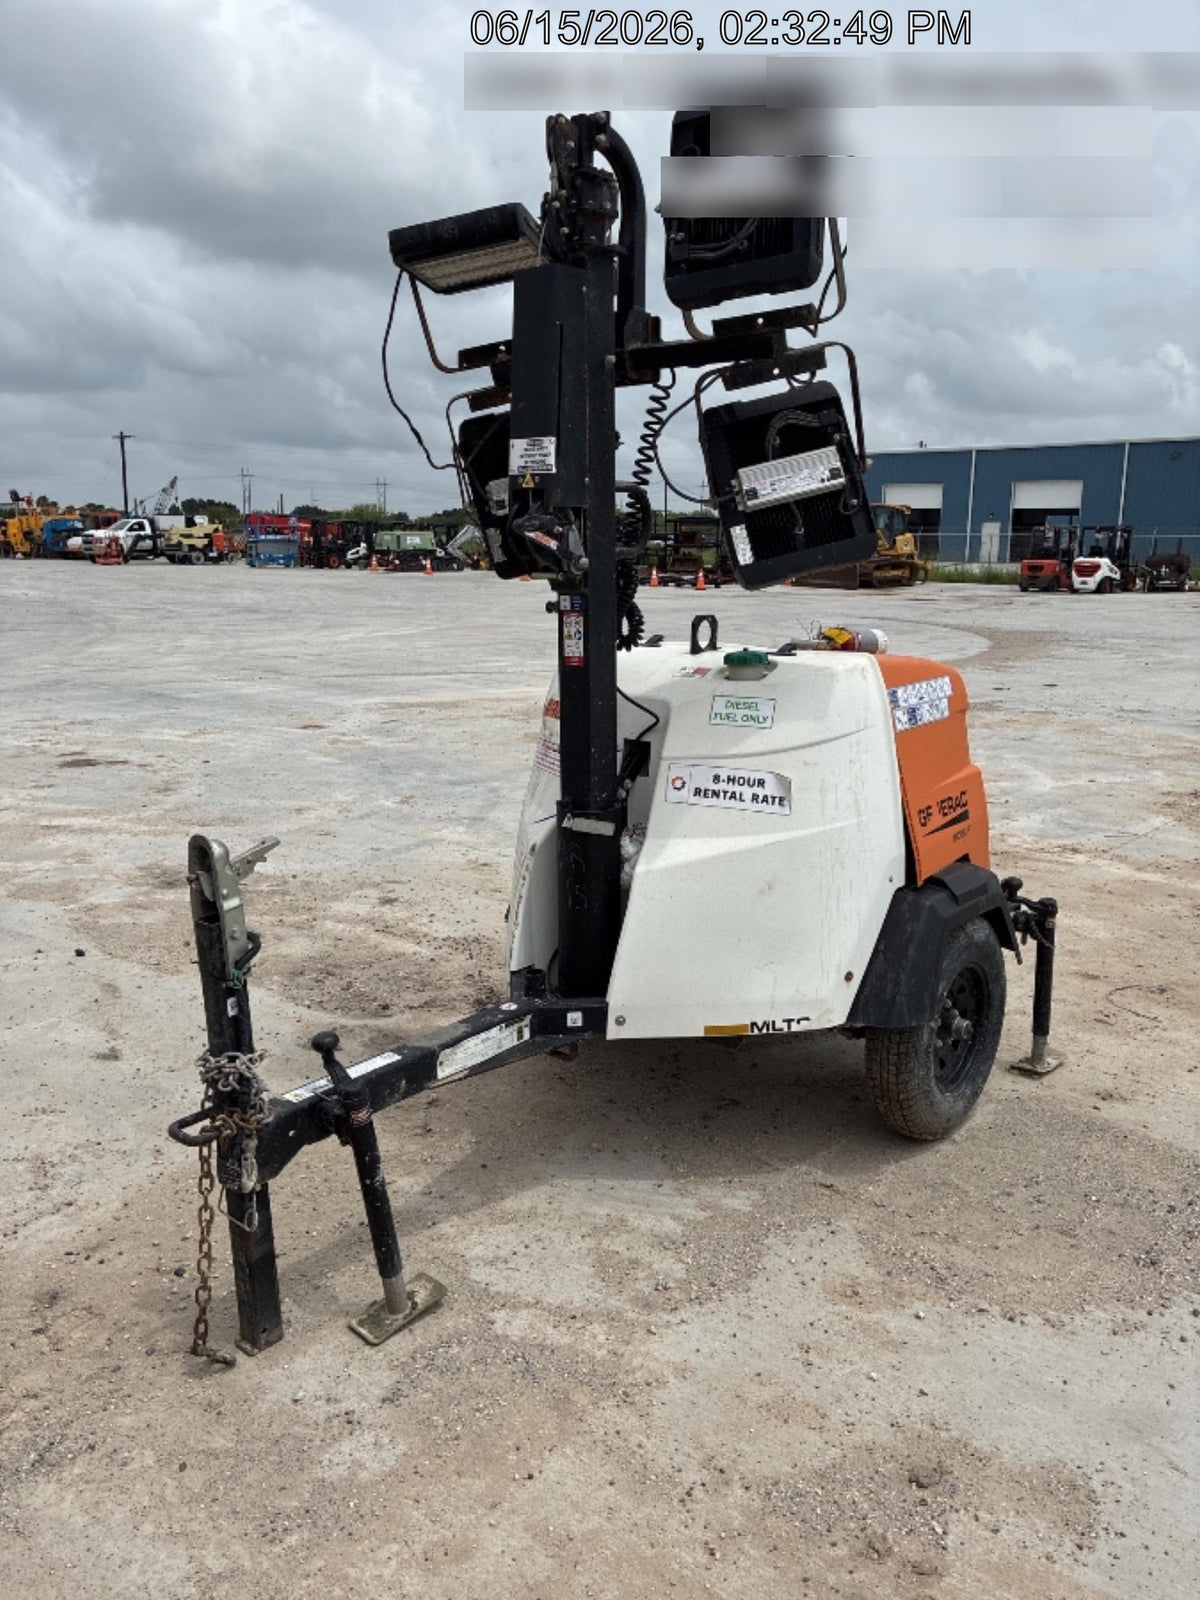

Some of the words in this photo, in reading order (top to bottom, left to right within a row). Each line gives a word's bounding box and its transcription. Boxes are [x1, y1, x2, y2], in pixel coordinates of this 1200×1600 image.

[724, 699, 761, 712] DIESEL
[712, 712, 739, 723] FUEL
[741, 713, 769, 725] ONLY
[712, 773, 766, 790] 8-HOUR
[693, 786, 746, 803] RENTAL
[751, 792, 787, 809] RATE
